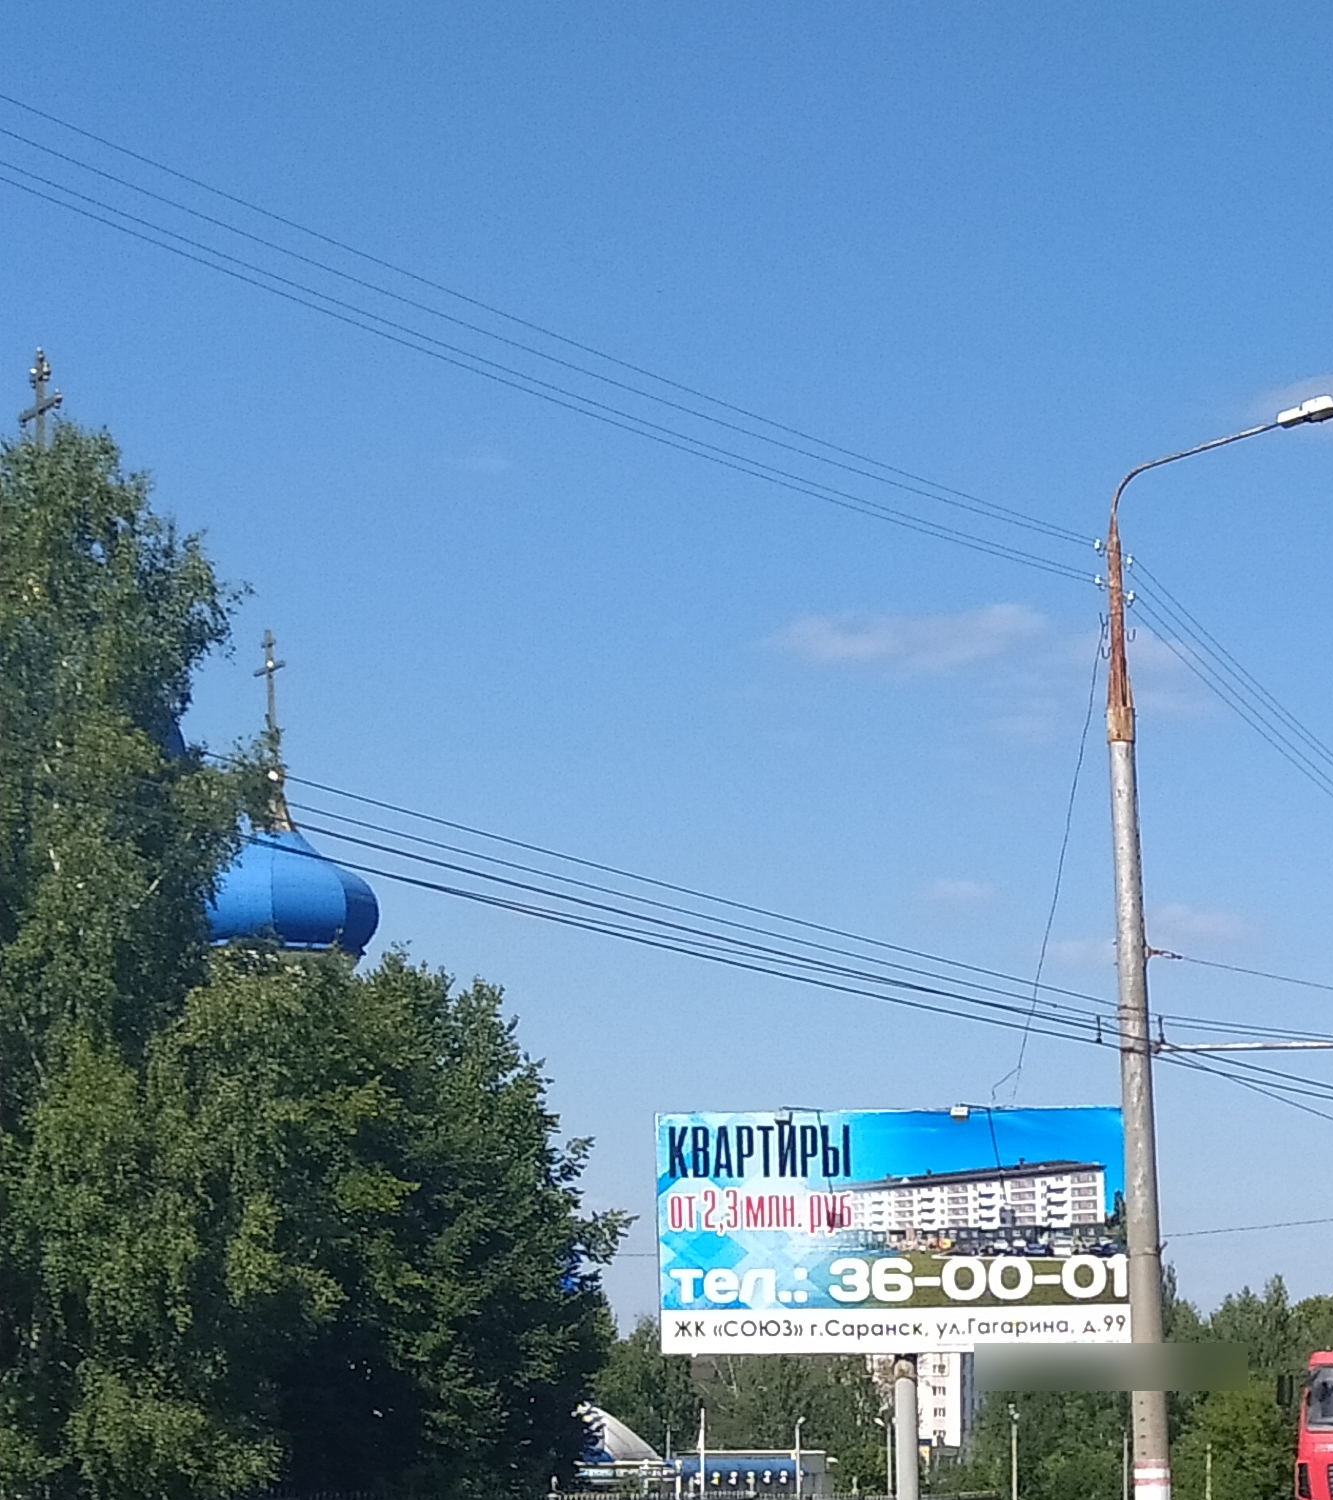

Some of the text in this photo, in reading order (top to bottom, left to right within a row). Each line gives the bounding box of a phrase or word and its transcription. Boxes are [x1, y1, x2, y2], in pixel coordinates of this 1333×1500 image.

[668, 1124, 852, 1178] КВАРТИРЫ
[703, 1189, 738, 1233] 2,3
[669, 1254, 1128, 1305] тел.: 36-00-01
[674, 1320, 706, 1337] ЖК
[713, 1319, 803, 1338] «СОЮЗ»
[1082, 1314, 1127, 1334] д.99
